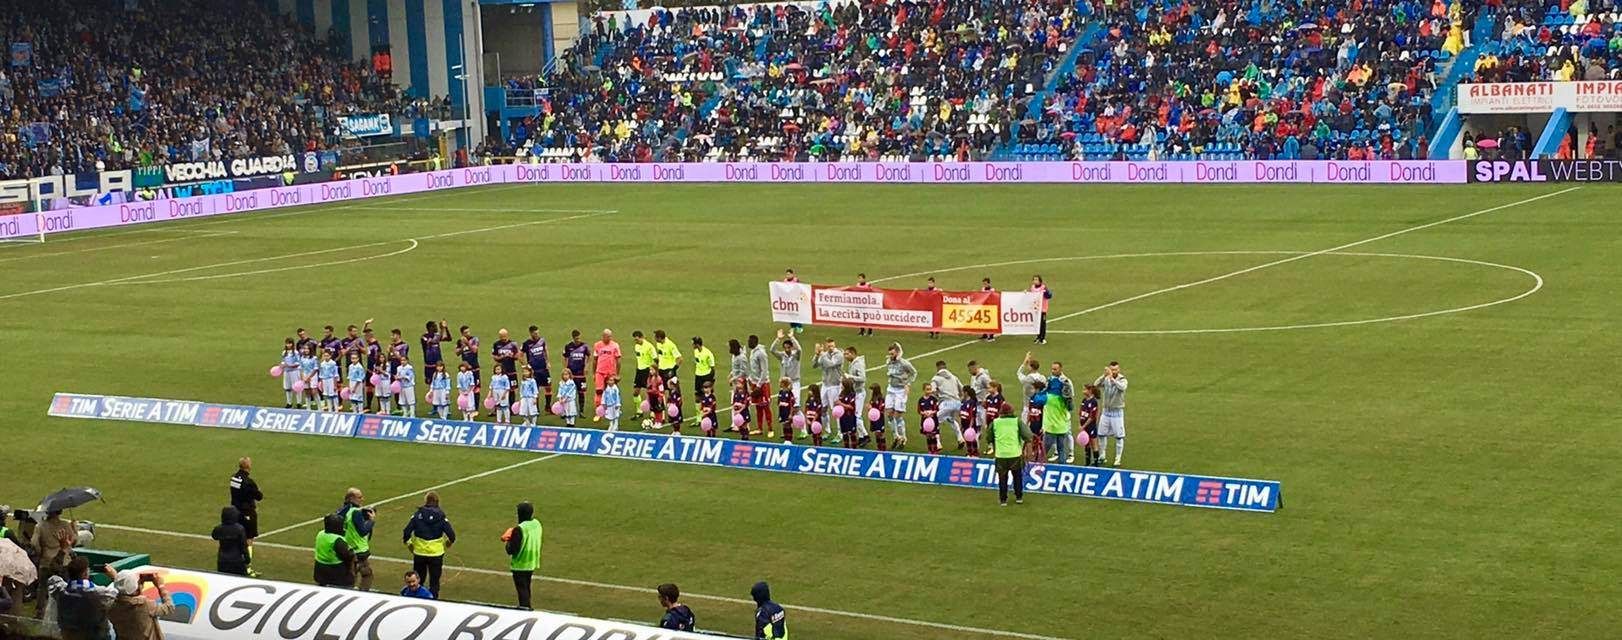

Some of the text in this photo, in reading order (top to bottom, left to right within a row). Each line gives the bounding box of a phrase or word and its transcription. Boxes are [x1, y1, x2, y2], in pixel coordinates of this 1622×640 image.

[1470, 84, 1553, 97] ALBANATI
[1576, 82, 1622, 95] IMPIA
[165, 161, 227, 182] VECCHIA
[231, 154, 297, 177] GUARDIA
[1476, 160, 1546, 181] SPAL
[120, 202, 156, 223] Dondi
[170, 199, 203, 218] Dondi
[226, 192, 258, 211] Dondi
[271, 188, 301, 206] Dondi
[321, 181, 351, 200] Dondi
[363, 178, 391, 196] Dondi
[427, 173, 454, 189] Dondi
[464, 168, 492, 184] Dondi
[517, 164, 549, 181] Dondi
[562, 164, 591, 181] Dondi
[611, 164, 641, 181] Dondi
[654, 164, 685, 181] Dondi
[726, 163, 758, 181] Dondi
[771, 163, 804, 181] Dondi
[827, 163, 862, 181] Dondi
[876, 163, 911, 181] Dondi
[935, 163, 970, 181] Dondi
[985, 163, 1022, 181] Dondi
[1072, 162, 1111, 181] Dondi
[1128, 162, 1168, 181] Dondi
[1196, 162, 1237, 181] Dondi
[1255, 162, 1297, 181] Dondi
[1327, 161, 1371, 181] Dondi
[1390, 161, 1435, 182] Dondi
[773, 297, 799, 312] cbm
[819, 293, 880, 305] Fermiamola.
[819, 308, 929, 324] La cecità può uccidere.
[1003, 307, 1034, 323] cbm
[71, 398, 97, 414] TIM
[101, 397, 146, 419] SERIE
[146, 401, 162, 421] A
[165, 402, 199, 424] TIM
[220, 408, 248, 425] TIM
[252, 408, 299, 432] SERIE
[300, 413, 317, 432] A
[320, 413, 356, 435] TIM
[381, 419, 410, 437] TIM
[416, 419, 467, 444] SERIE
[471, 424, 489, 445] A
[493, 424, 531, 449] TIM
[559, 432, 591, 451] TIM
[597, 432, 655, 458] SERIE
[657, 435, 677, 460] A
[680, 437, 724, 463] TIM
[754, 446, 790, 468] TIM
[799, 448, 864, 475] SERIE
[866, 453, 887, 478] A
[891, 454, 939, 482] TIM
[1025, 465, 1098, 495] SERIE
[1101, 472, 1124, 498] A
[1129, 473, 1185, 502] TIM
[1225, 483, 1271, 507] TIM
[208, 584, 438, 640] GIULIO
